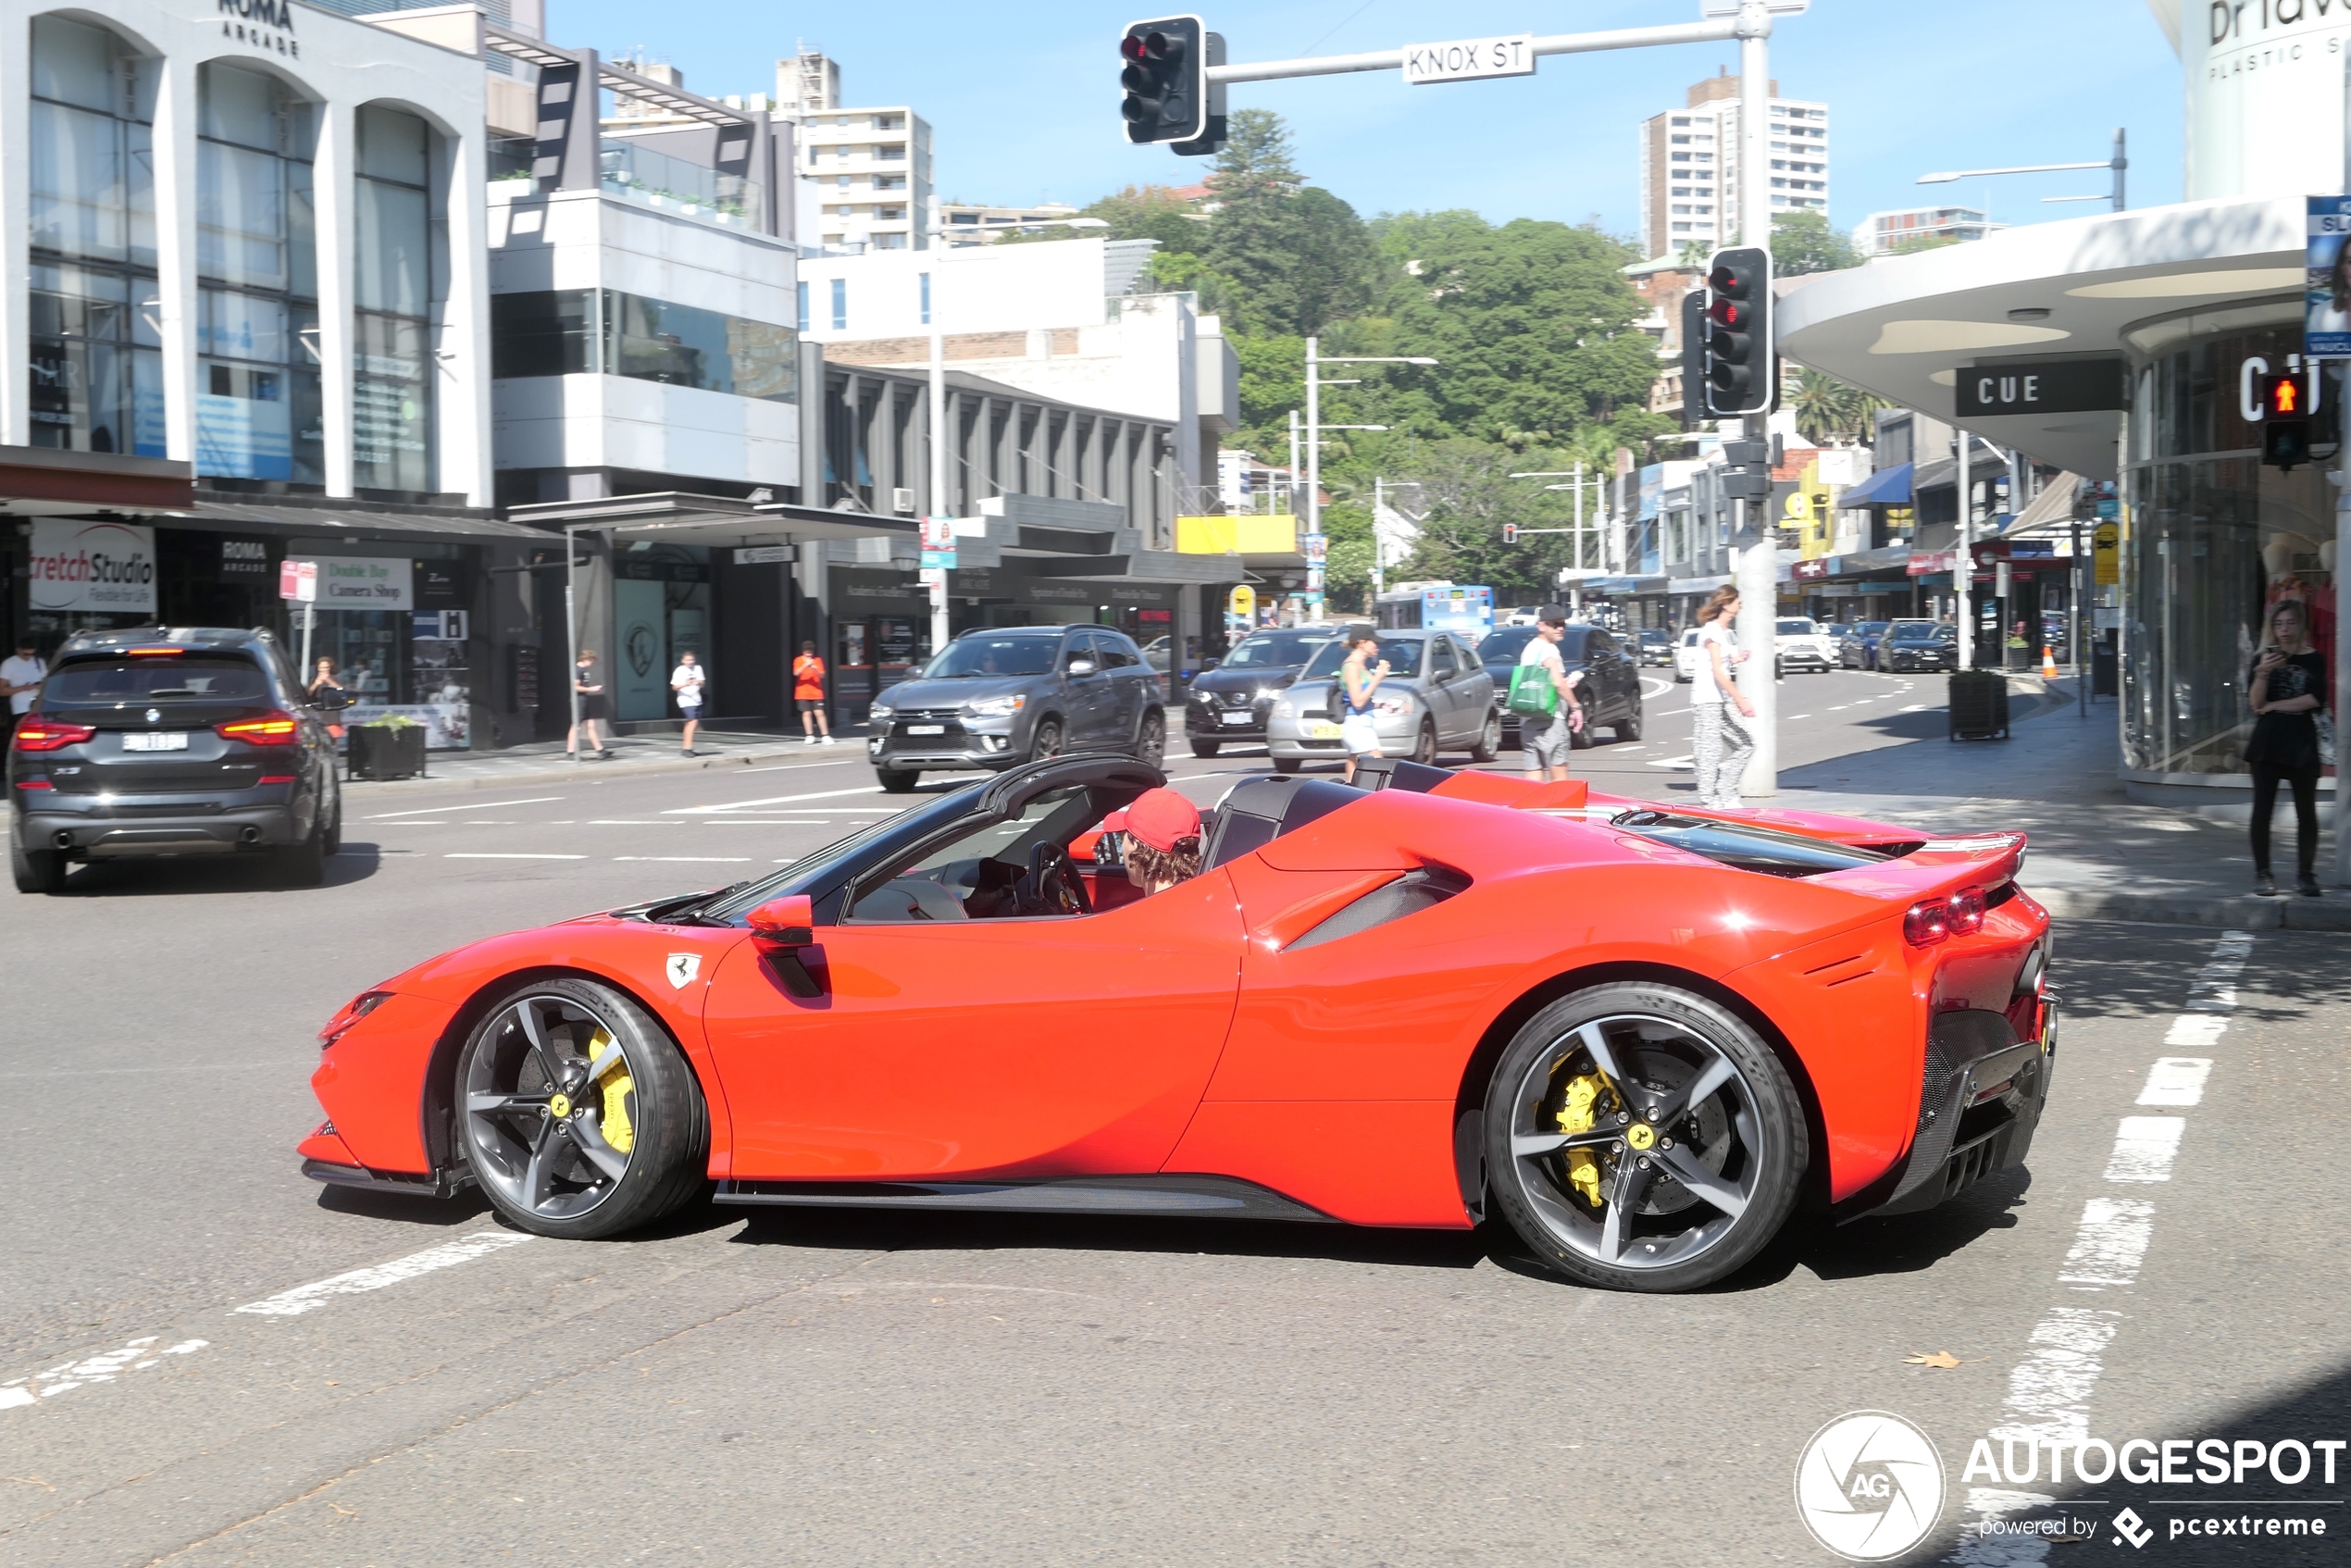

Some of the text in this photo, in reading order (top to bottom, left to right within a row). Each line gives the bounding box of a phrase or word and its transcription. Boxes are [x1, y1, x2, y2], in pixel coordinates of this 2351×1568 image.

[2210, 1, 2245, 46] Dr
[222, 20, 300, 59] ARCADE
[1409, 41, 1524, 76] KNOX ST
[2209, 44, 2303, 83] PLASTIC
[2322, 217, 2351, 232] SL
[1978, 375, 2039, 404] CUE
[223, 541, 267, 559] ROMA
[223, 563, 267, 572] ARCADE
[329, 563, 390, 581] Double Bay
[329, 583, 401, 601] Camera Shop
